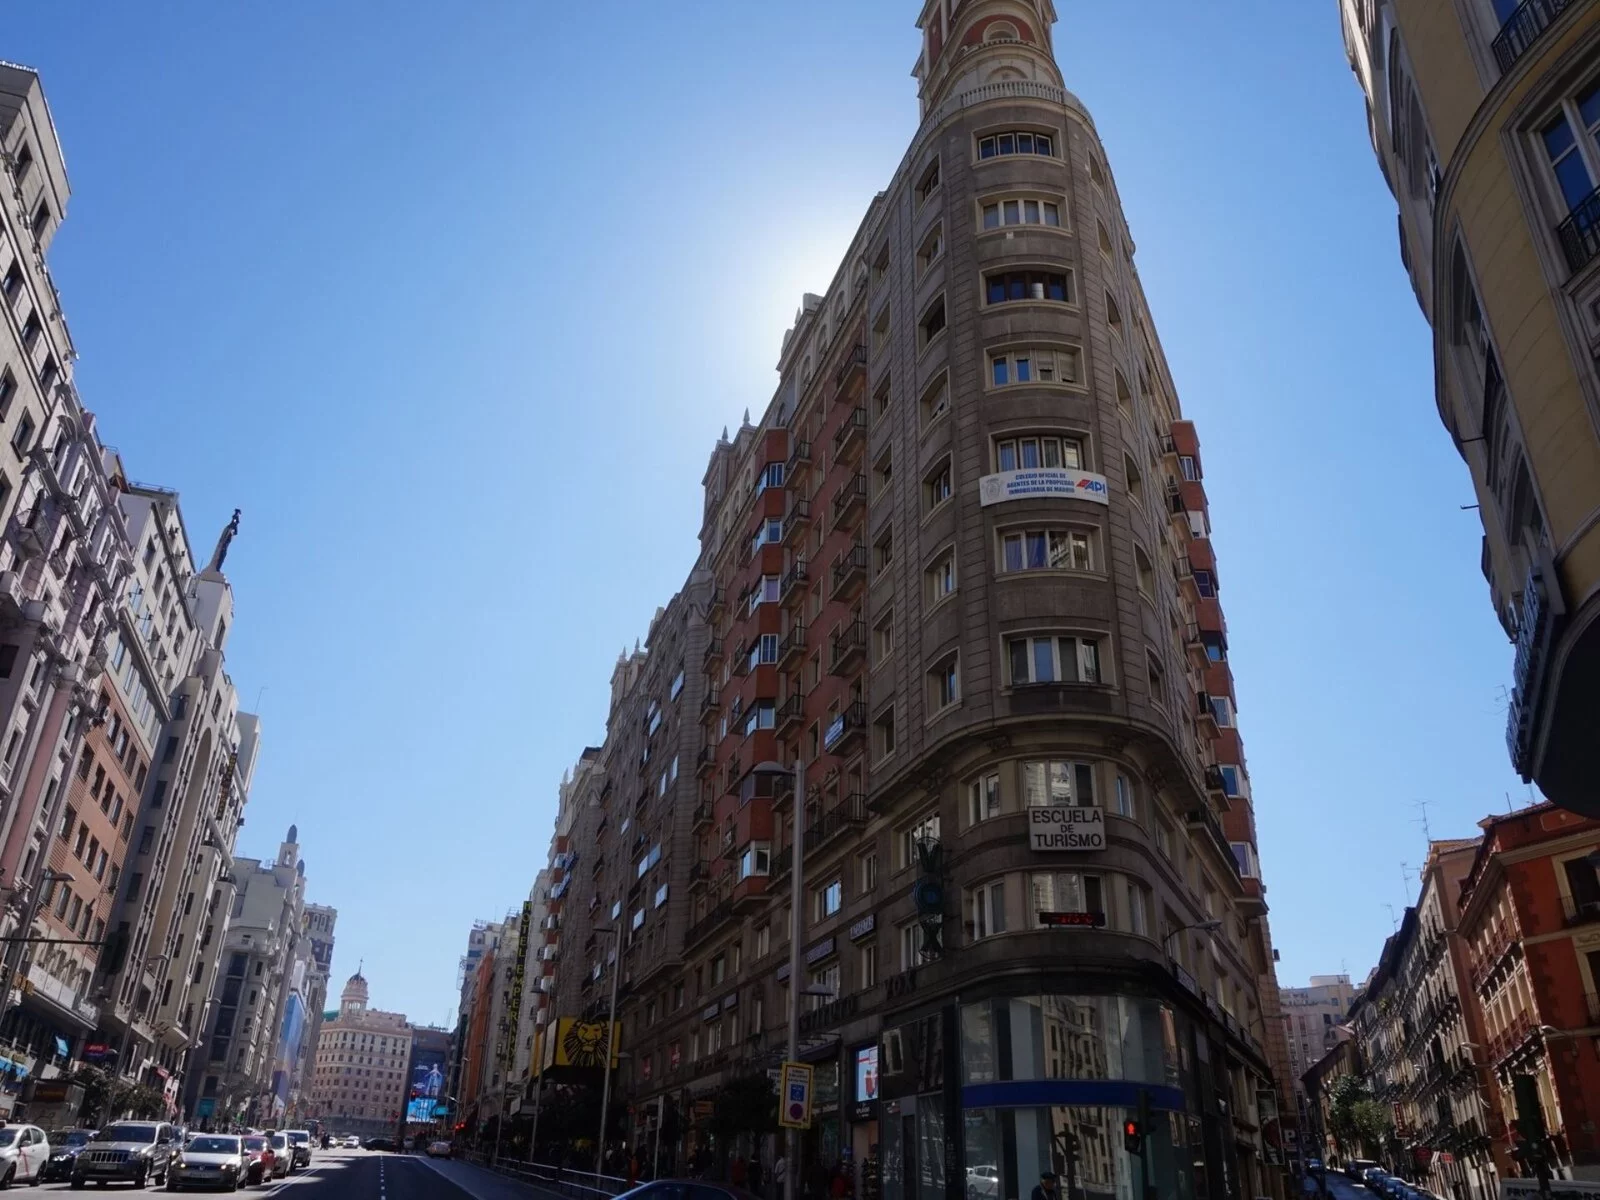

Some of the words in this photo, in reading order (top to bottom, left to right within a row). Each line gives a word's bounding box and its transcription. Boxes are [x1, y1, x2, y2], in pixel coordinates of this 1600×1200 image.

[1032, 810, 1102, 824] ESCUELA
[1060, 824, 1075, 834] DE
[1034, 833, 1101, 847] TURISMO
[518, 902, 531, 957] HOTEL
[1284, 1129, 1296, 1143] P
